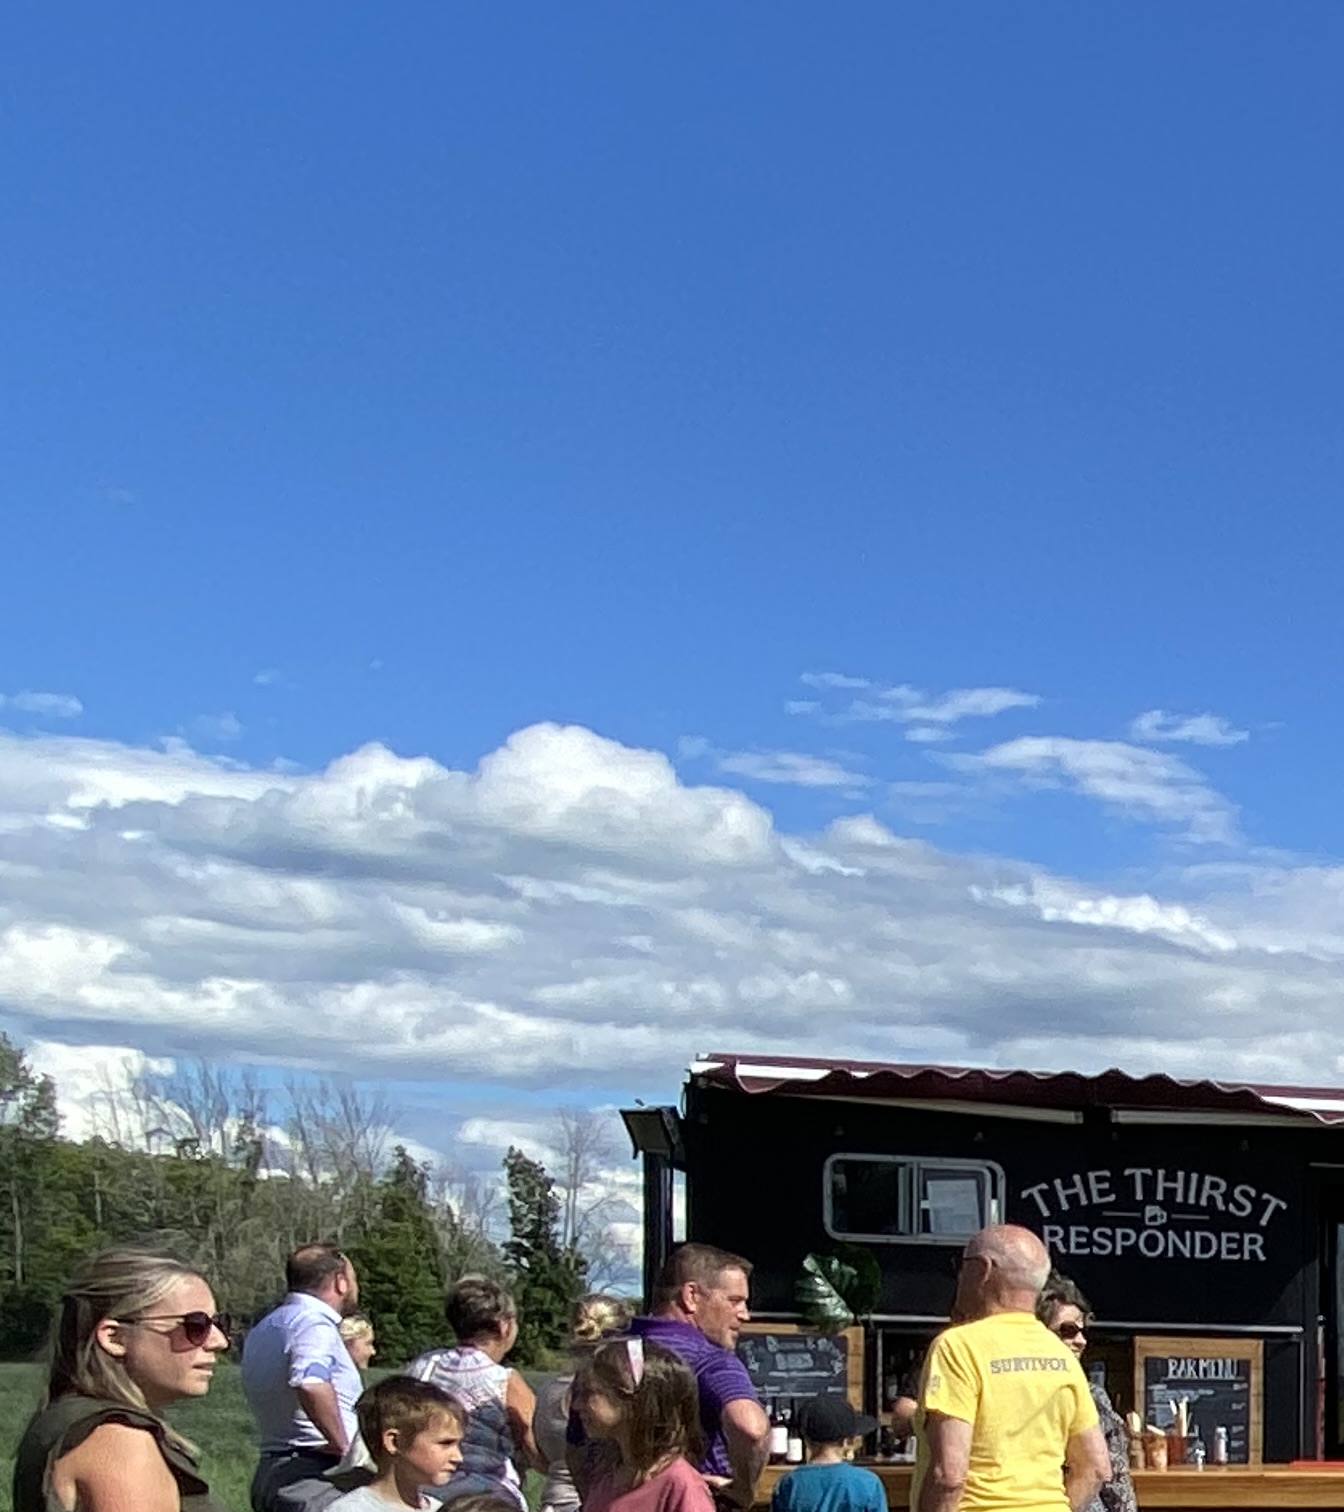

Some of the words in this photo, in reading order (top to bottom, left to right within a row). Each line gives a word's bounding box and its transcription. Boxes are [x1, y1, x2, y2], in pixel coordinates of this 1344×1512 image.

[1021, 1170, 1116, 1217] THE
[1124, 1168, 1288, 1227] THIRST
[1042, 1225, 1267, 1262] RESPONDER
[1167, 1358, 1198, 1379] BAR
[1199, 1358, 1239, 1379] MENU
